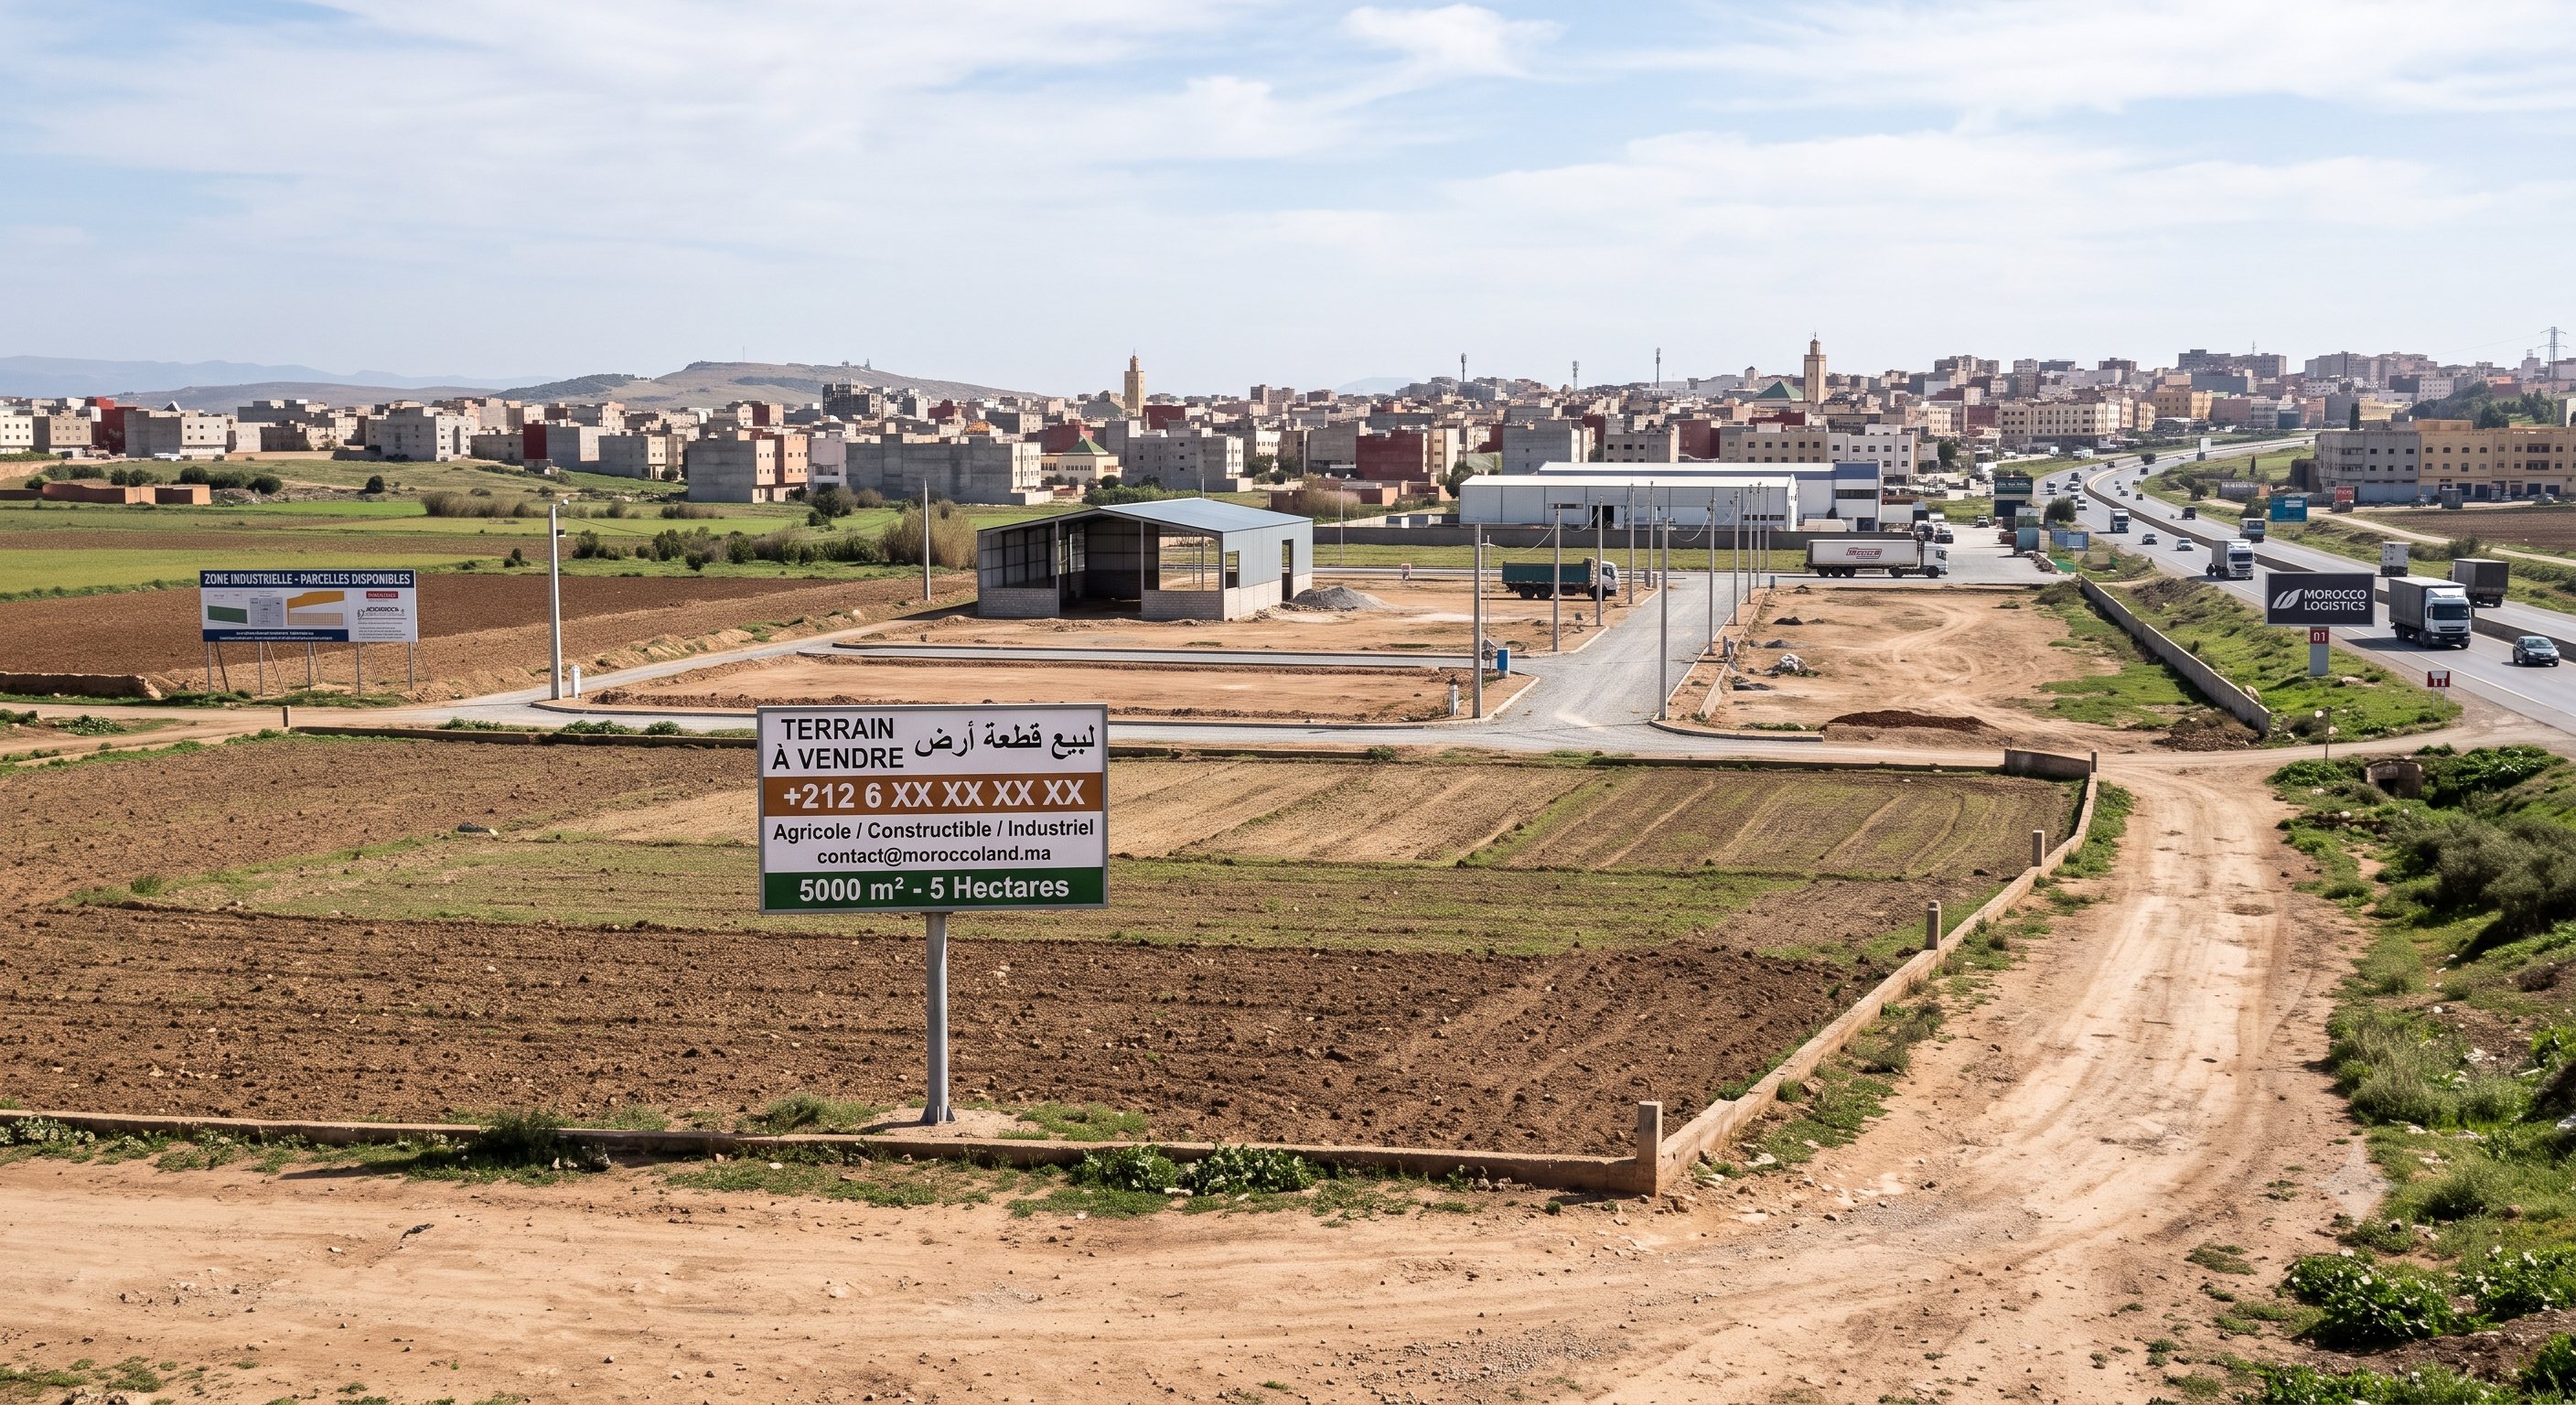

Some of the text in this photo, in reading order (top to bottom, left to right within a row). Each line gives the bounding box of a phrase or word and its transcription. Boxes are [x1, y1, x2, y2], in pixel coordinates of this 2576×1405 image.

[204, 573, 230, 585] ZONE
[231, 573, 293, 585] INDUSTRIELLE
[300, 573, 350, 585] PARCELLES
[351, 573, 411, 585] DISPONIBLES
[2304, 589, 2367, 600] MOROCCO
[2304, 601, 2366, 611] LOGISTICS
[780, 717, 894, 741] TERRAIN
[914, 720, 1095, 760] لبيع قطعة أرض
[771, 743, 905, 770] À VENDRE
[783, 778, 1086, 810] +212 6 XX XX XX XX
[772, 818, 1094, 845] Agricole / Constructible / Industriel
[816, 845, 1053, 868] contact@moroccoland.ma
[800, 877, 861, 902] 5000
[870, 876, 905, 900] m²
[929, 876, 945, 900] 5
[953, 875, 1069, 899] Hectares
